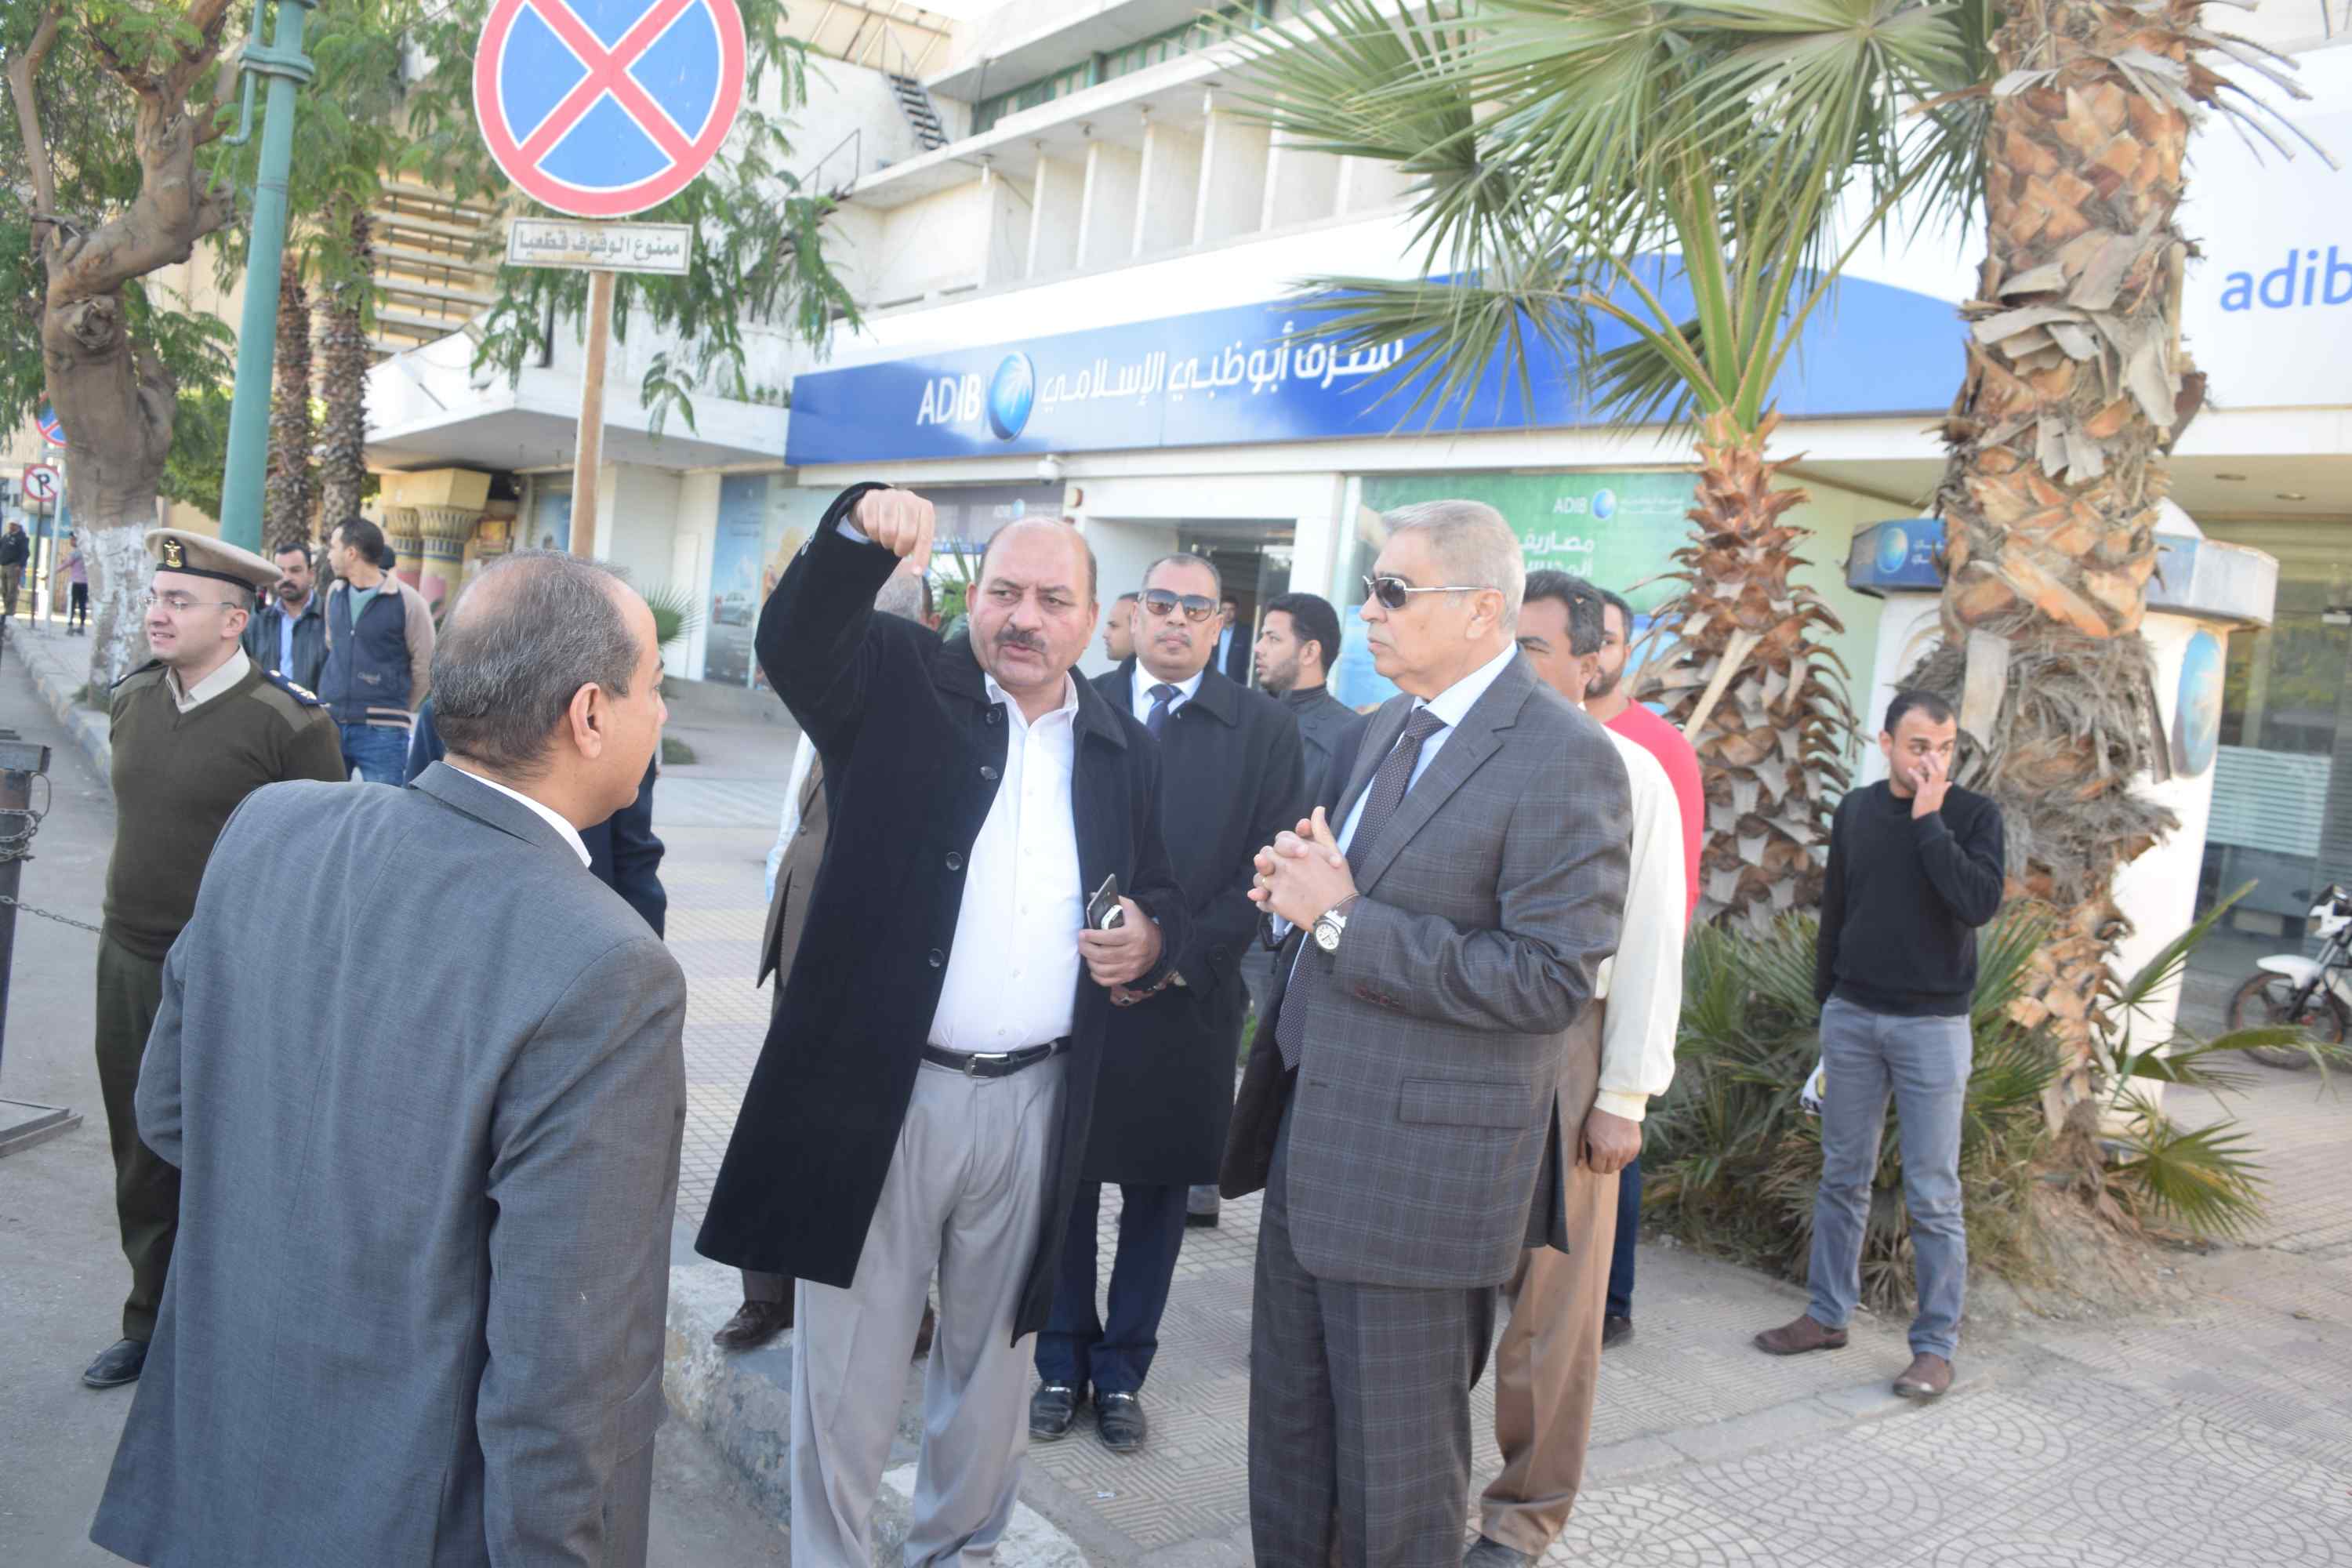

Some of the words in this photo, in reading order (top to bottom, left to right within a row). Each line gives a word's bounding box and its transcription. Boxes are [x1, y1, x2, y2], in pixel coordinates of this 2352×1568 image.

[572, 231, 630, 258] الوقوف
[633, 235, 680, 261] ممنوع
[2220, 245, 2352, 311] adib
[1040, 350, 1167, 414] الإسلامي
[1167, 319, 1294, 401] أبوظبي
[916, 372, 982, 426] ADIB
[1553, 495, 1588, 514] ADIB
